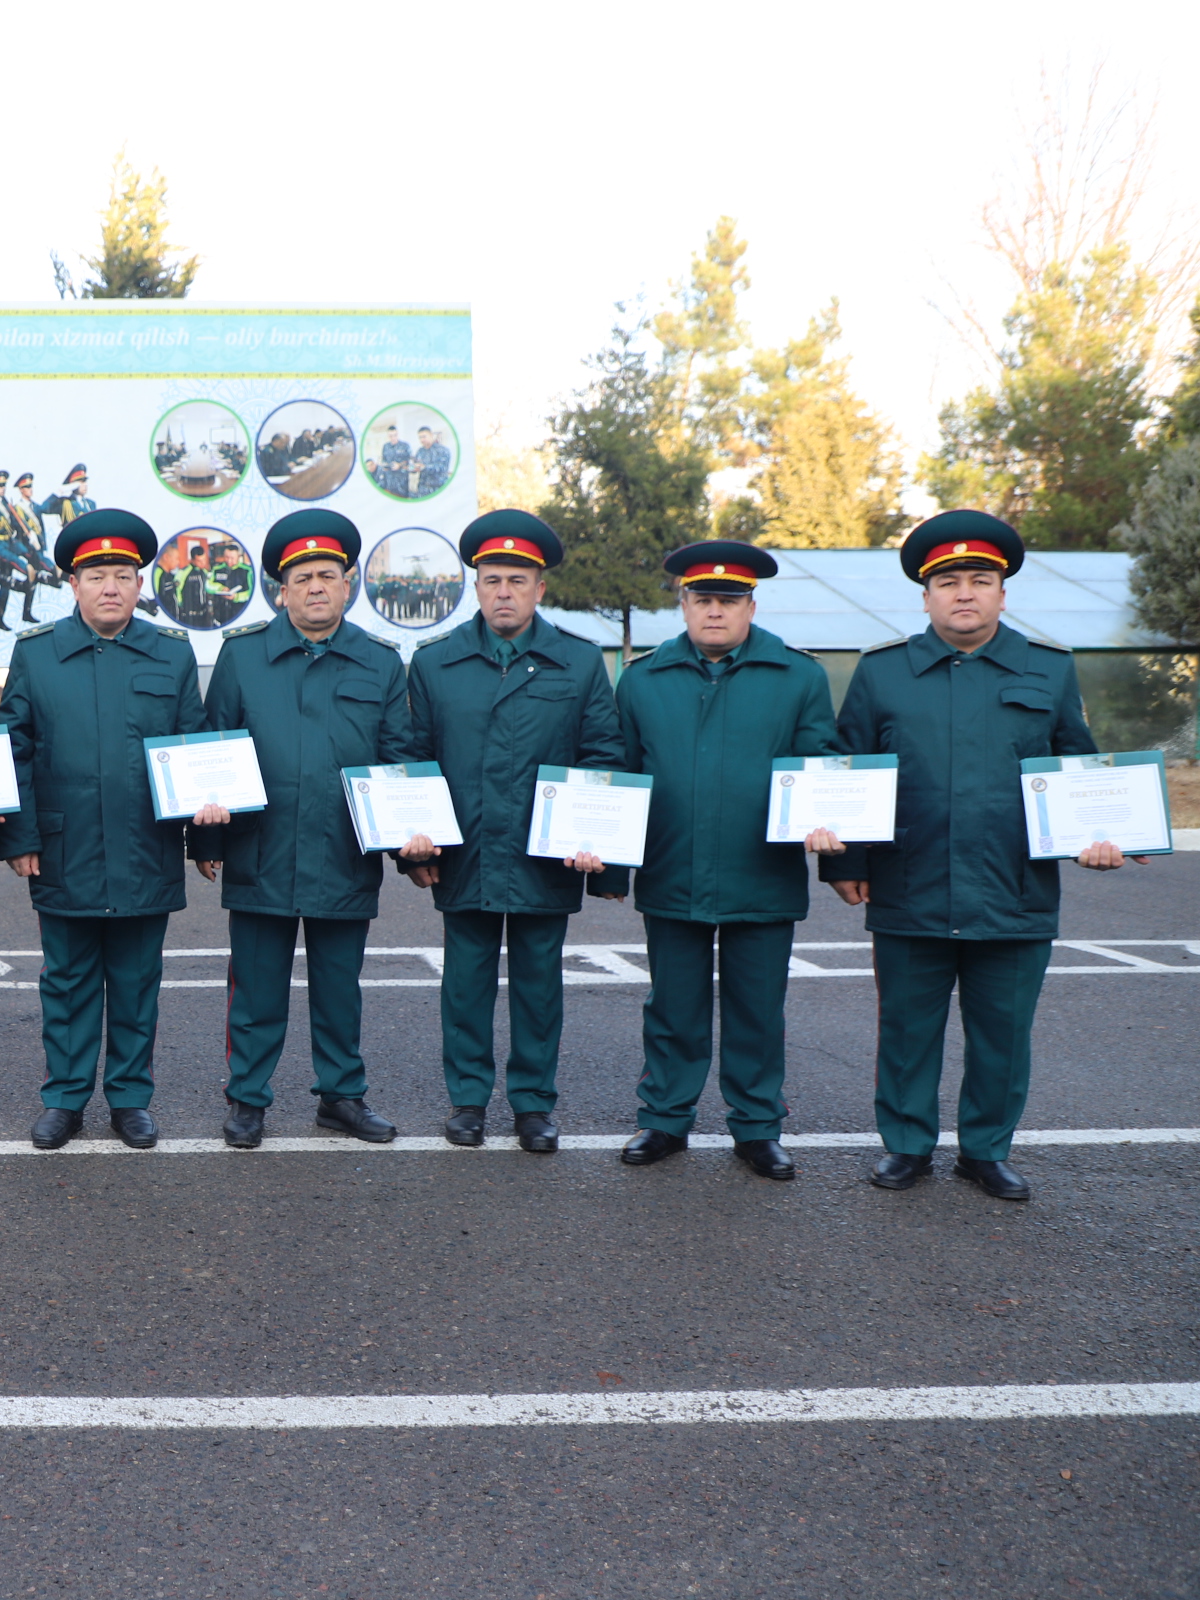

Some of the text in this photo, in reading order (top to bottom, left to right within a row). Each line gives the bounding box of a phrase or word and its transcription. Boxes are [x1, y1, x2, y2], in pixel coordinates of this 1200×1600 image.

[50, 328, 125, 346] xizmat
[130, 327, 191, 351] qilish
[225, 327, 265, 351] oliy
